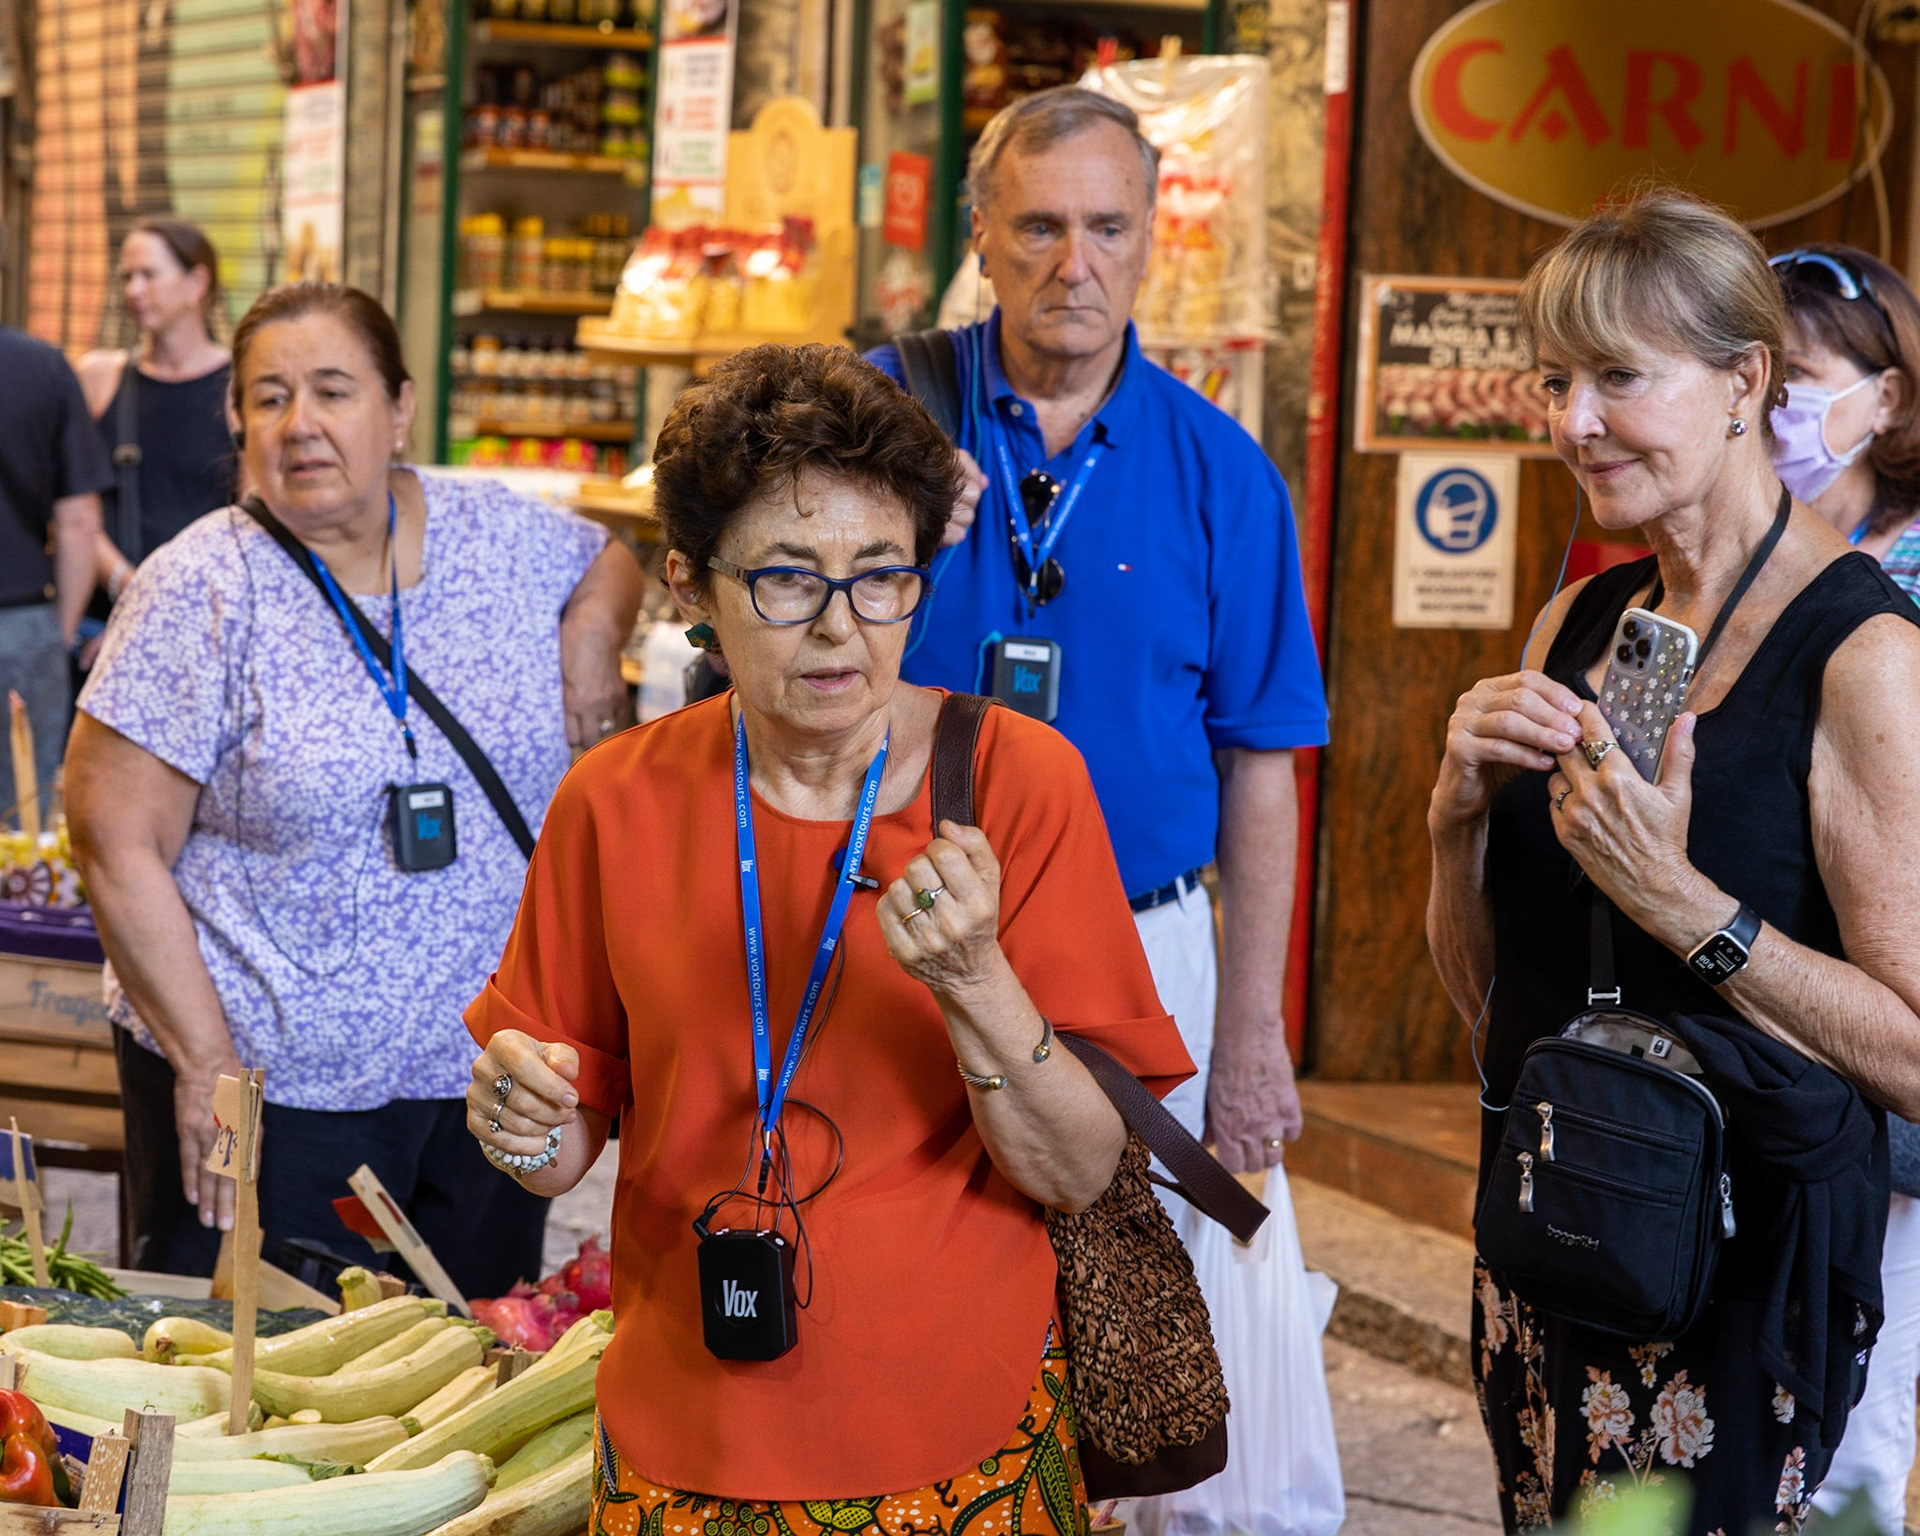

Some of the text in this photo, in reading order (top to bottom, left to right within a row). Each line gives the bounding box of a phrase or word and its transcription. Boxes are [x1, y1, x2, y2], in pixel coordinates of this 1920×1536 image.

[1430, 37, 1859, 163] CARNI
[1014, 665, 1042, 693] Vox
[417, 813, 442, 840] Vox
[736, 722, 748, 828] www.voxtours.com
[748, 926, 765, 1036] www.voxtours.com
[782, 981, 820, 1087] www.voxtours.com
[722, 1279, 759, 1318] Vox
